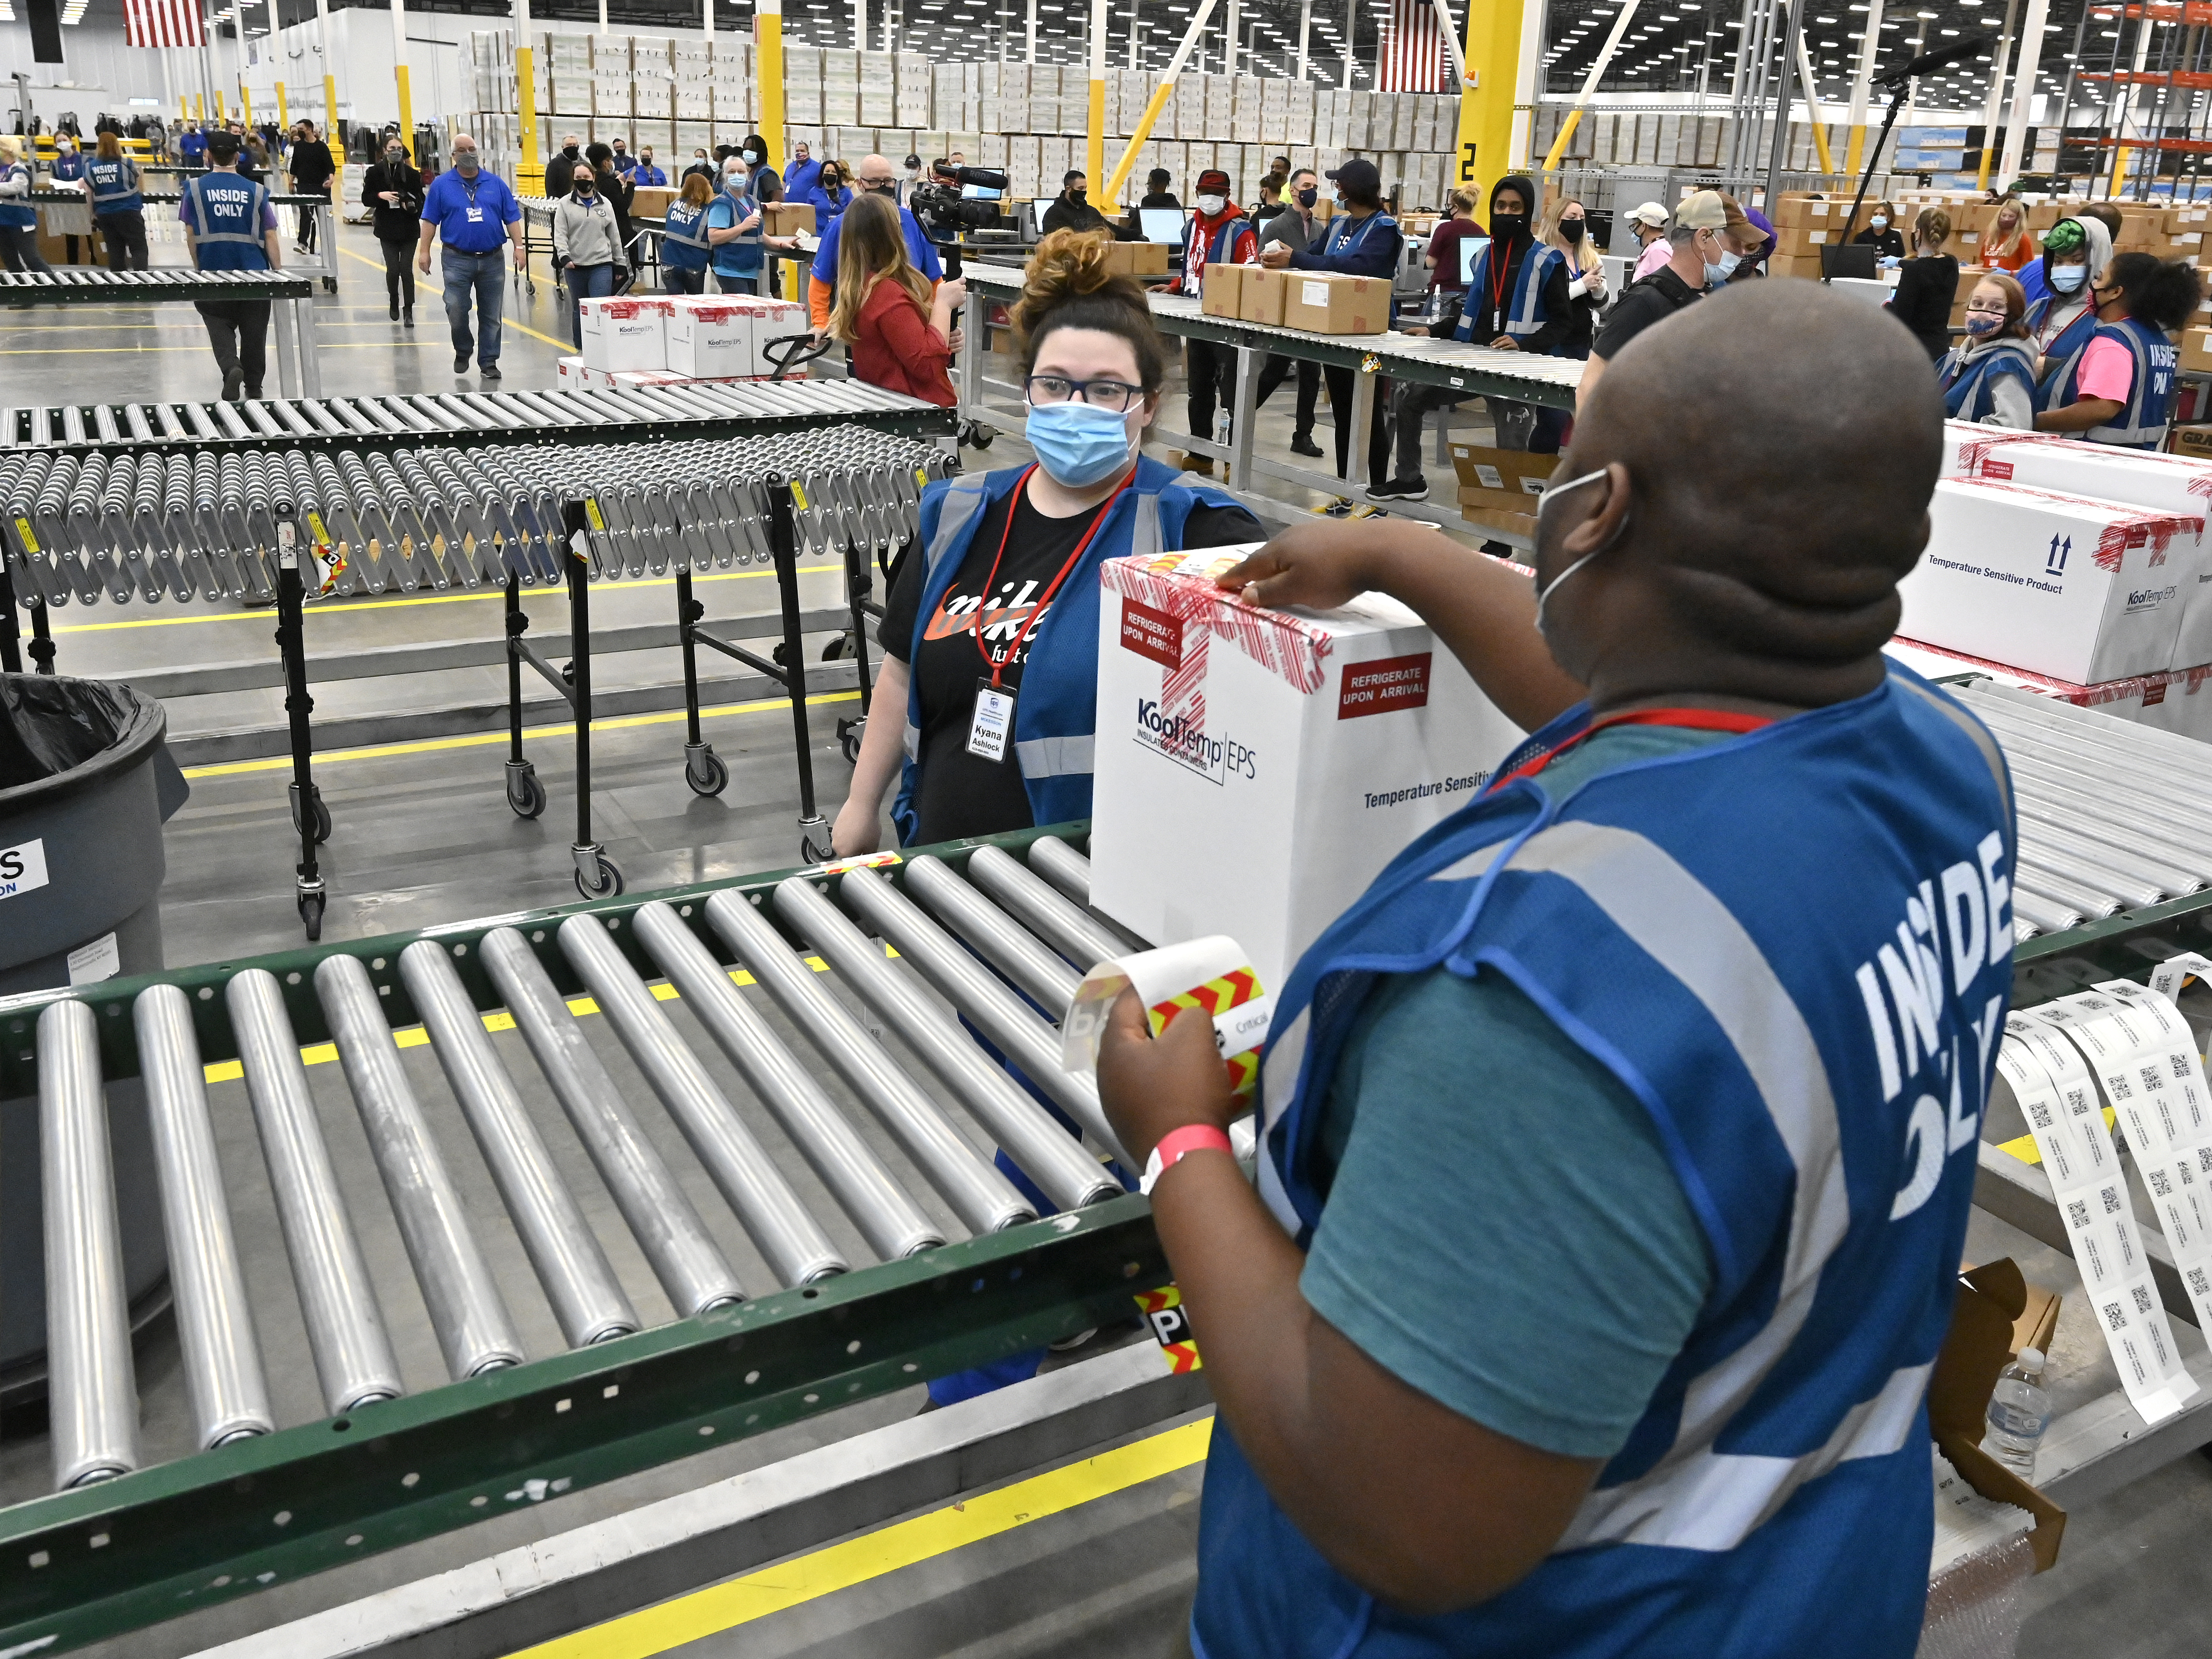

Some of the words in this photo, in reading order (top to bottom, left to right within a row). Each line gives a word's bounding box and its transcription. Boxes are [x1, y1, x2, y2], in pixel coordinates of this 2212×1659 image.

[1461, 143, 1476, 181] 2
[96, 174, 117, 184] ONLY
[207, 189, 248, 204] INSIDE
[214, 204, 243, 217] ONLY
[670, 210, 695, 225] ONLY
[1929, 554, 1982, 575] Temperature
[1983, 568, 2024, 585] Sensitive
[2026, 578, 2063, 594] Product
[2127, 589, 2163, 605] KoolTemp
[2164, 585, 2177, 599] EPS
[1123, 624, 1143, 642] UPON
[1146, 635, 1179, 657] ARRIVAL
[1351, 667, 1421, 688] REFRIGERATE
[1343, 690, 1374, 705] UPON
[1379, 683, 1425, 699] ARRIVAL
[975, 724, 1002, 741] Kyana
[1137, 728, 1169, 752] INSULATED
[1138, 698, 1221, 768] KoolTemp
[1227, 741, 1256, 779] EPS
[972, 737, 1000, 753] Ashlock
[1364, 781, 1442, 809] Temperature
[1444, 770, 1490, 793] Sensiti
[1855, 830, 2013, 1103] INSIDE
[1236, 1012, 1268, 1034] Critical
